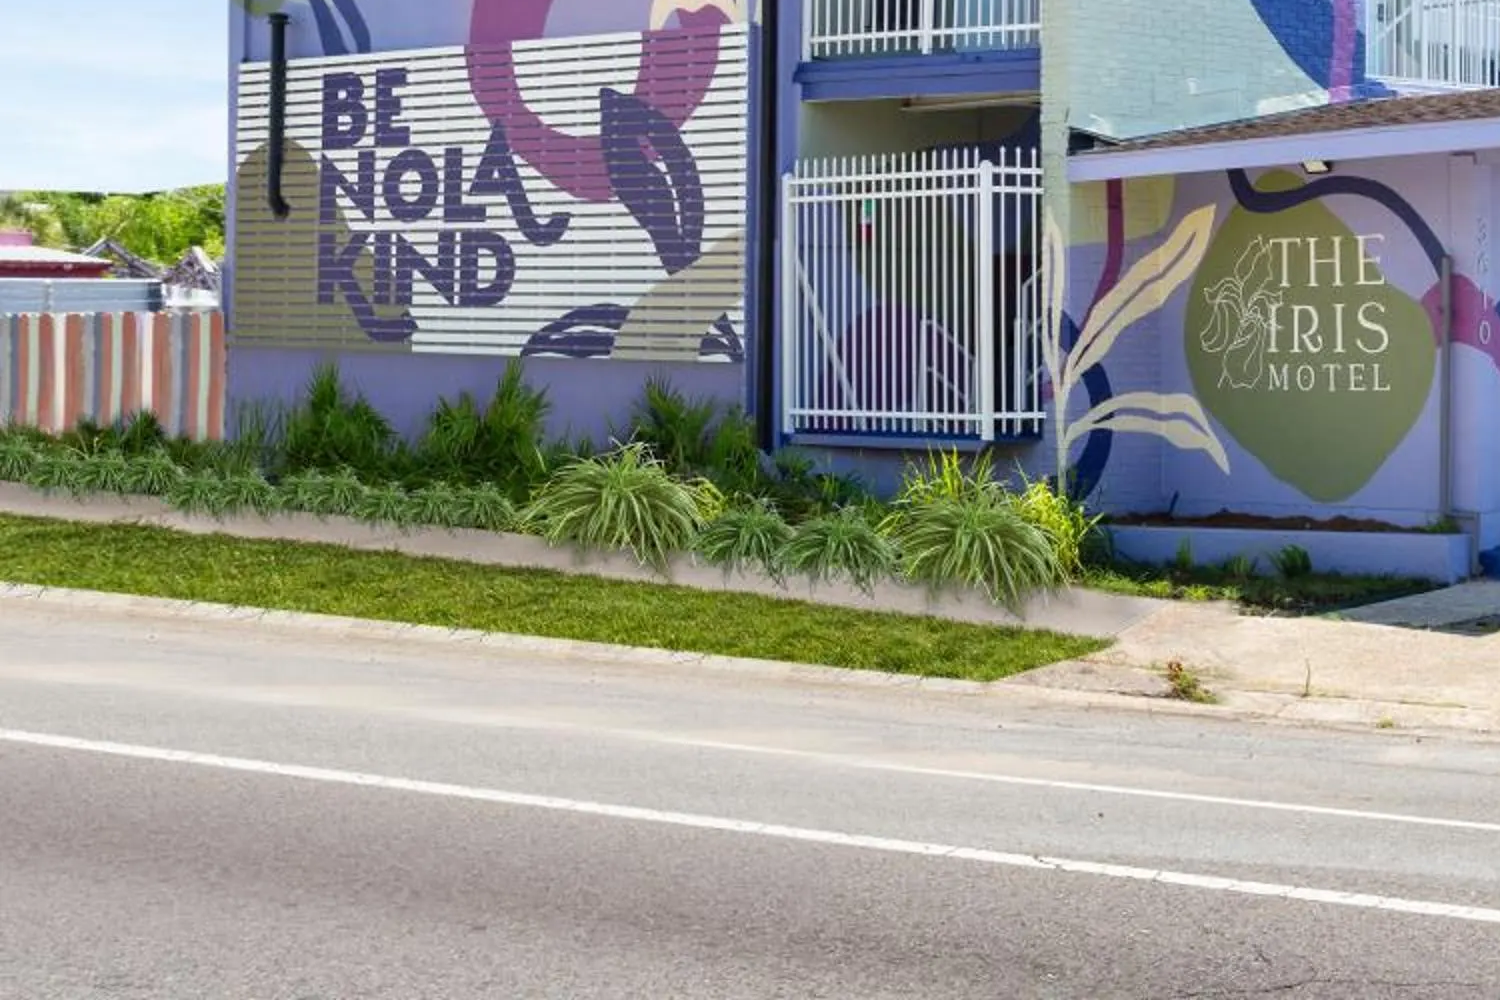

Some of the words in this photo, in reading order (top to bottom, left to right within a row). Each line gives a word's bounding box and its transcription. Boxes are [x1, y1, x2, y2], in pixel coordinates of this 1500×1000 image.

[321, 66, 410, 150] BE
[319, 121, 571, 247] NOLA
[316, 230, 516, 343] KIND
[1270, 233, 1386, 288] THE
[1267, 301, 1389, 354] IRIS
[1268, 363, 1391, 392] MOTEL
